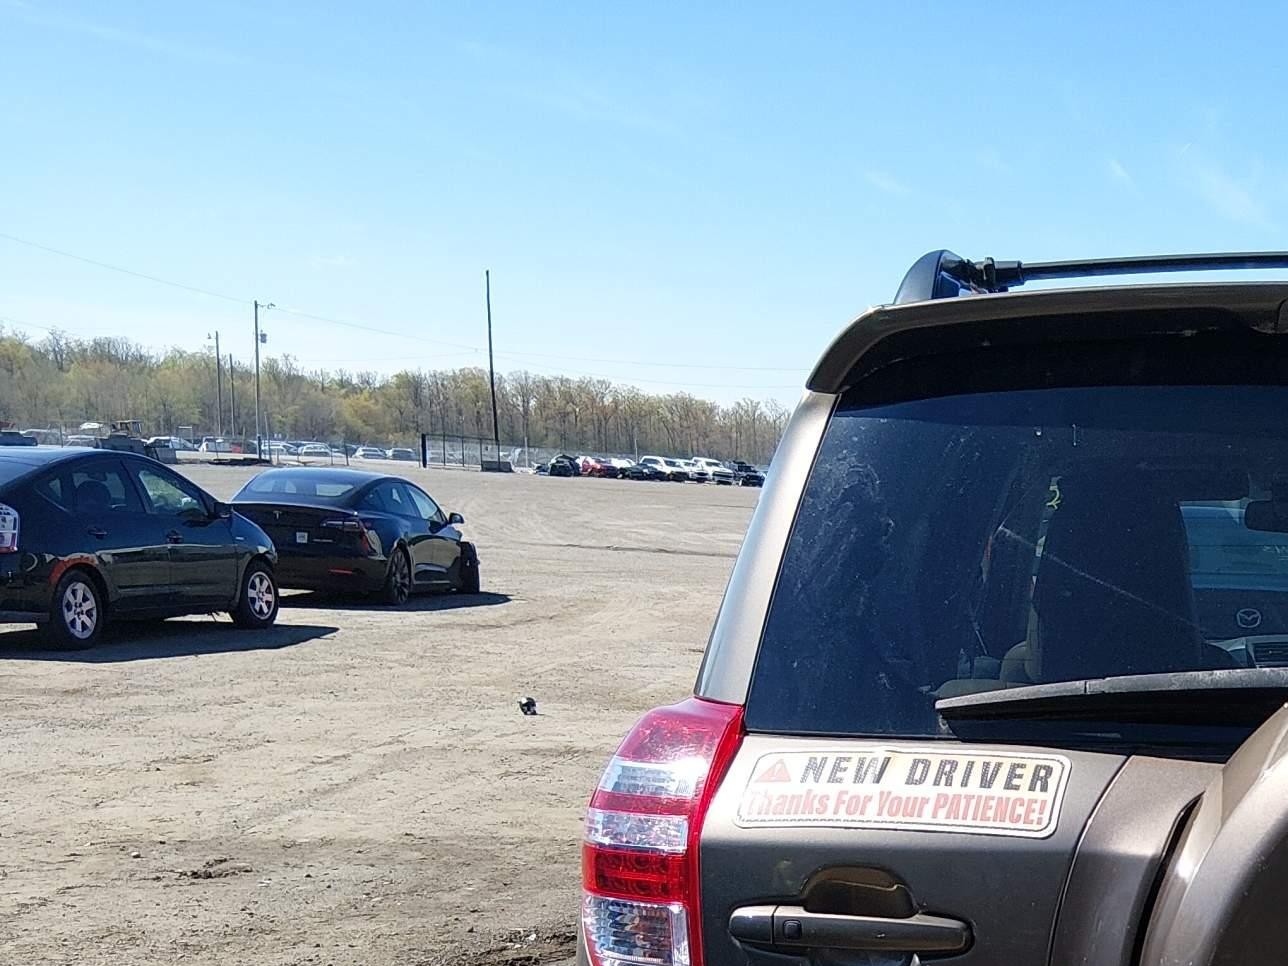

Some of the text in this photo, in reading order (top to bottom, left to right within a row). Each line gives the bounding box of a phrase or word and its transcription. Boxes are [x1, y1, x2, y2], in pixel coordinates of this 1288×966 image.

[800, 755, 1055, 793] NEW DRIVER
[748, 789, 1048, 826] Thanks For Your PATIENCE!
